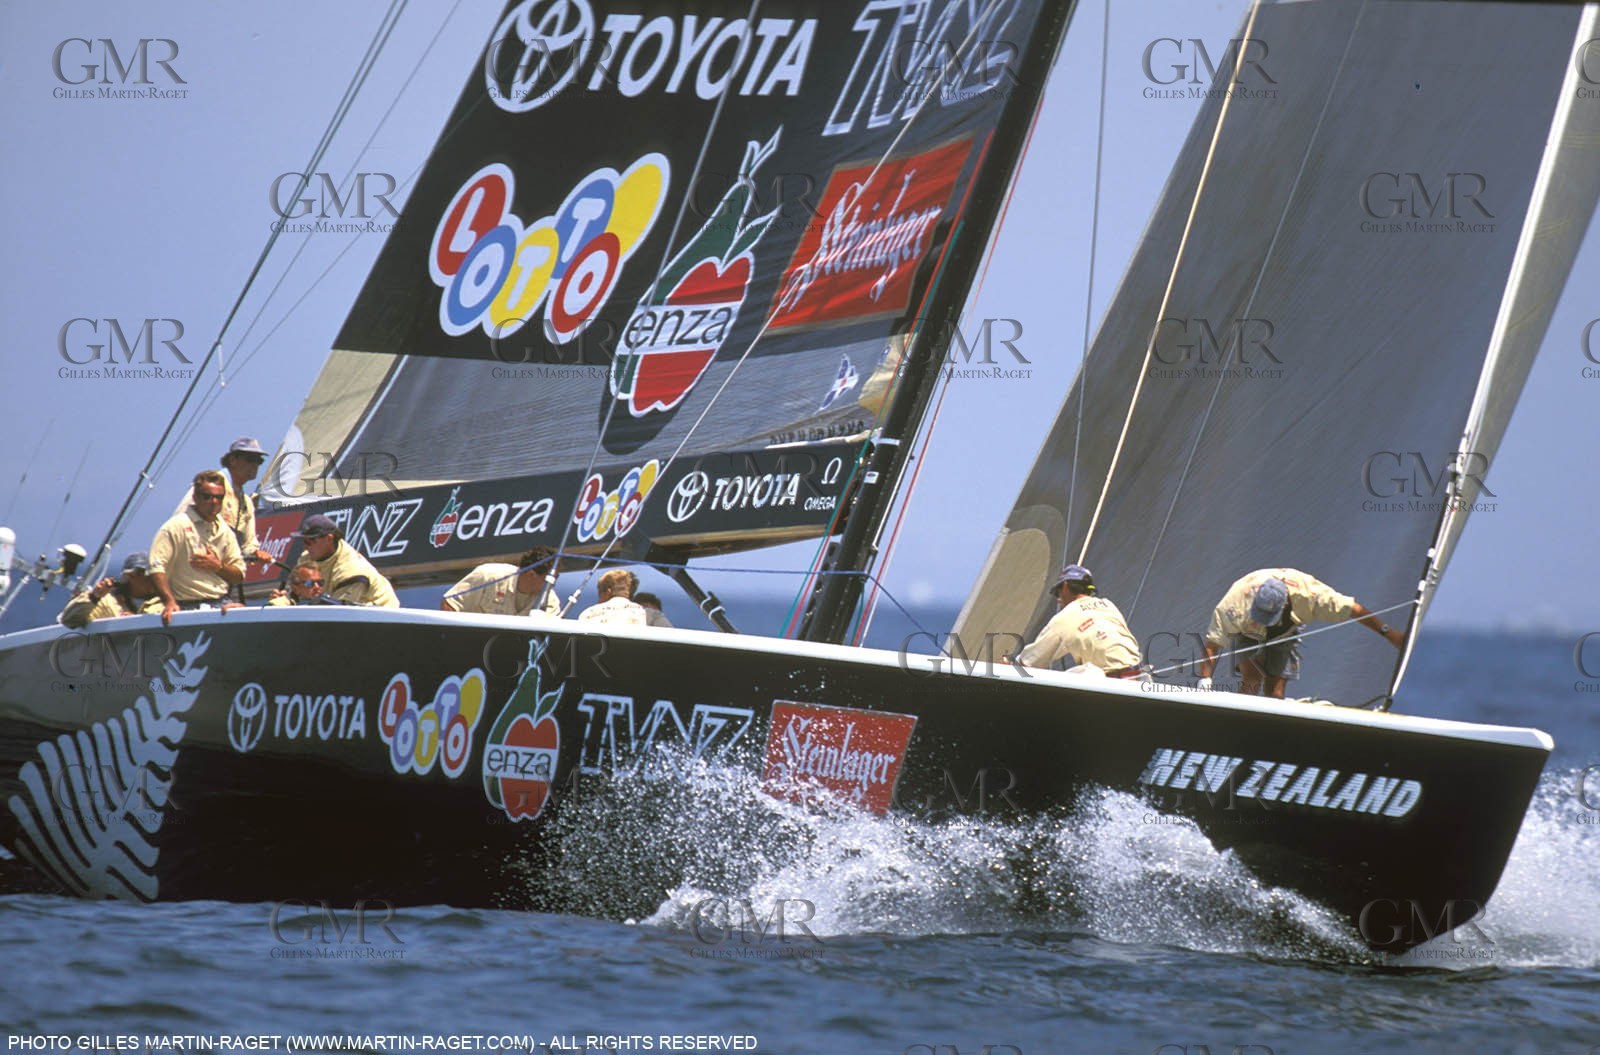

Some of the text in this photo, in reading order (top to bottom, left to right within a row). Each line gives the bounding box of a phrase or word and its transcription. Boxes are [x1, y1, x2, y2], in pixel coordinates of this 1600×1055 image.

[587, 14, 818, 100] TOYOTA
[624, 306, 733, 348] enza
[711, 473, 801, 511] TOYOTA
[804, 495, 838, 511] OMEGA
[457, 498, 554, 541] enza
[274, 694, 366, 740] TOYOTA
[487, 748, 551, 776] enza
[768, 714, 896, 800] Steinlager
[1138, 748, 1422, 818] NEW ZEALAND
